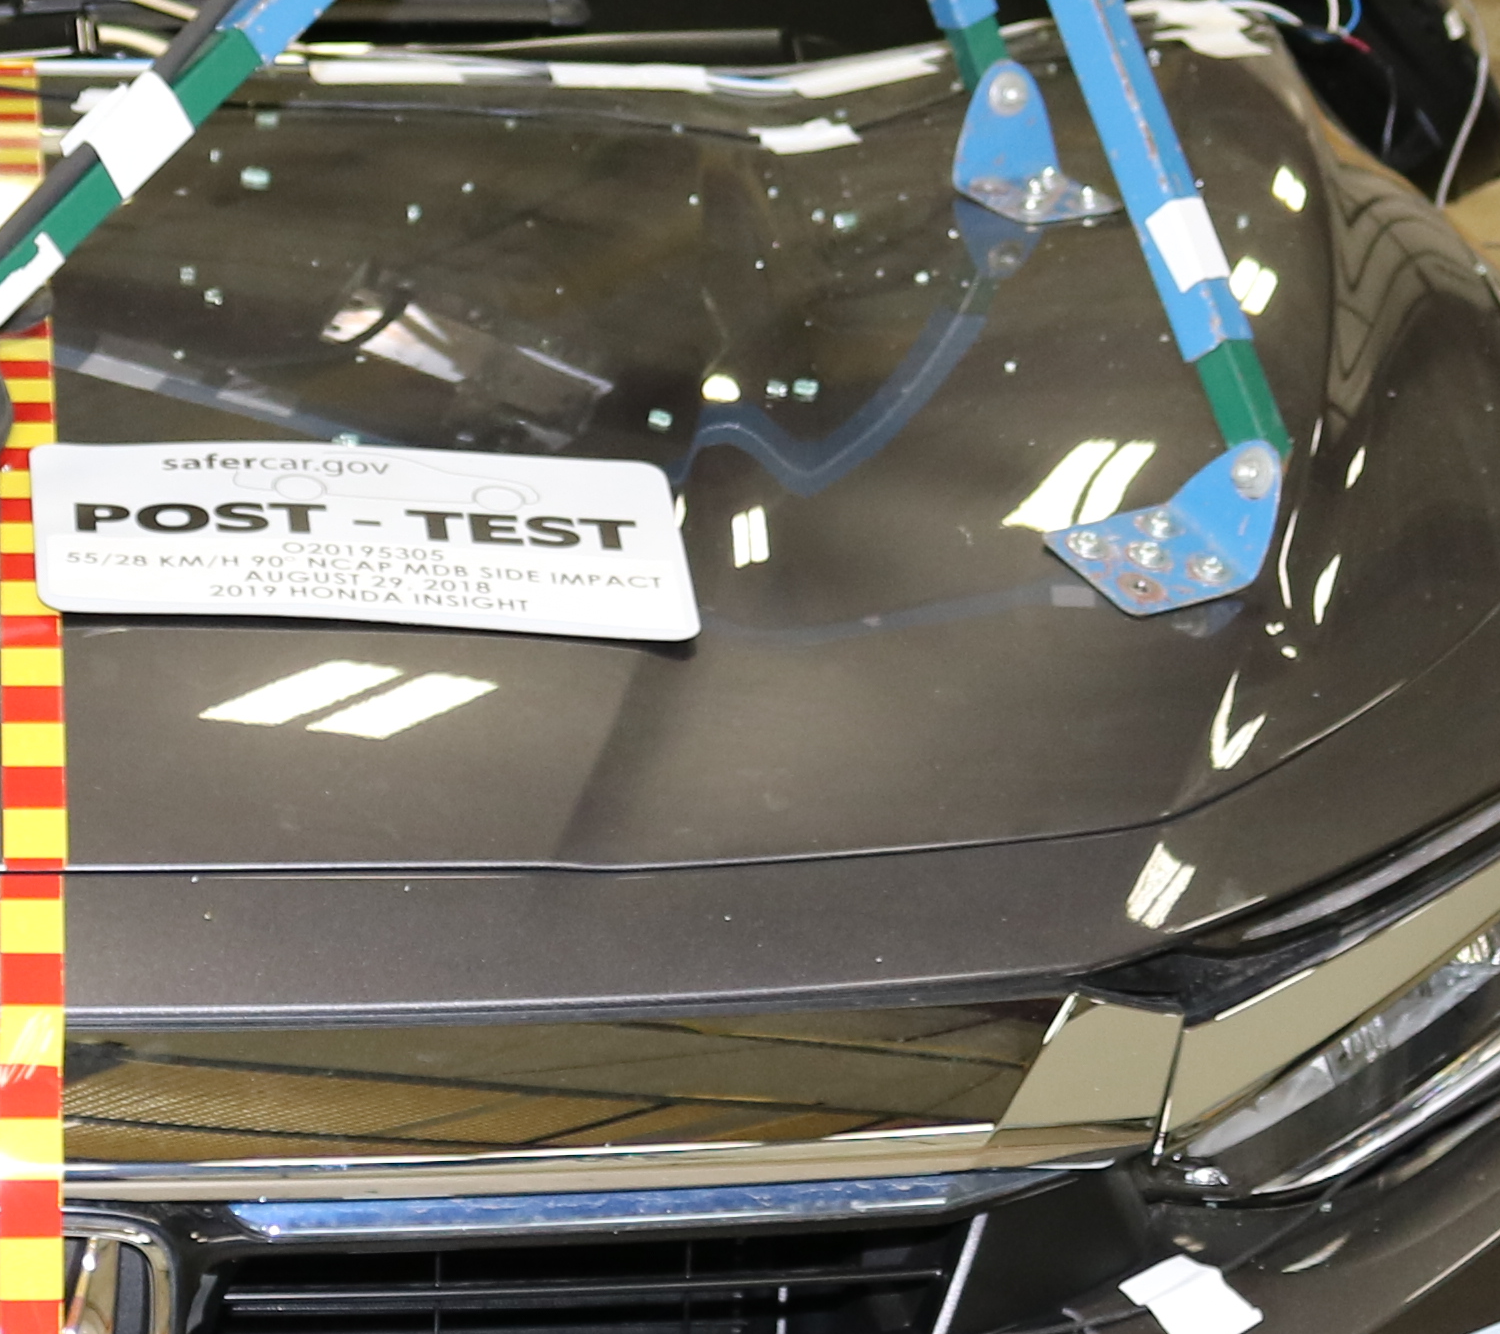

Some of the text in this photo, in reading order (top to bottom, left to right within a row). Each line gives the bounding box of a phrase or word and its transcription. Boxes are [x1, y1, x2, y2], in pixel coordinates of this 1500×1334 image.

[162, 453, 389, 476] safercar.gov
[74, 502, 327, 534] POST
[404, 509, 637, 550] TEST
[66, 551, 149, 568] 55/28
[159, 554, 240, 569] KM/H
[307, 557, 393, 573] NCAP
[404, 563, 469, 578] MDB
[480, 566, 541, 583] SIDE
[551, 571, 662, 589] IMPACT
[244, 570, 361, 587] AUGUST
[424, 578, 492, 594] 2018
[209, 584, 530, 612] 2019 HONDA INSIGHT
